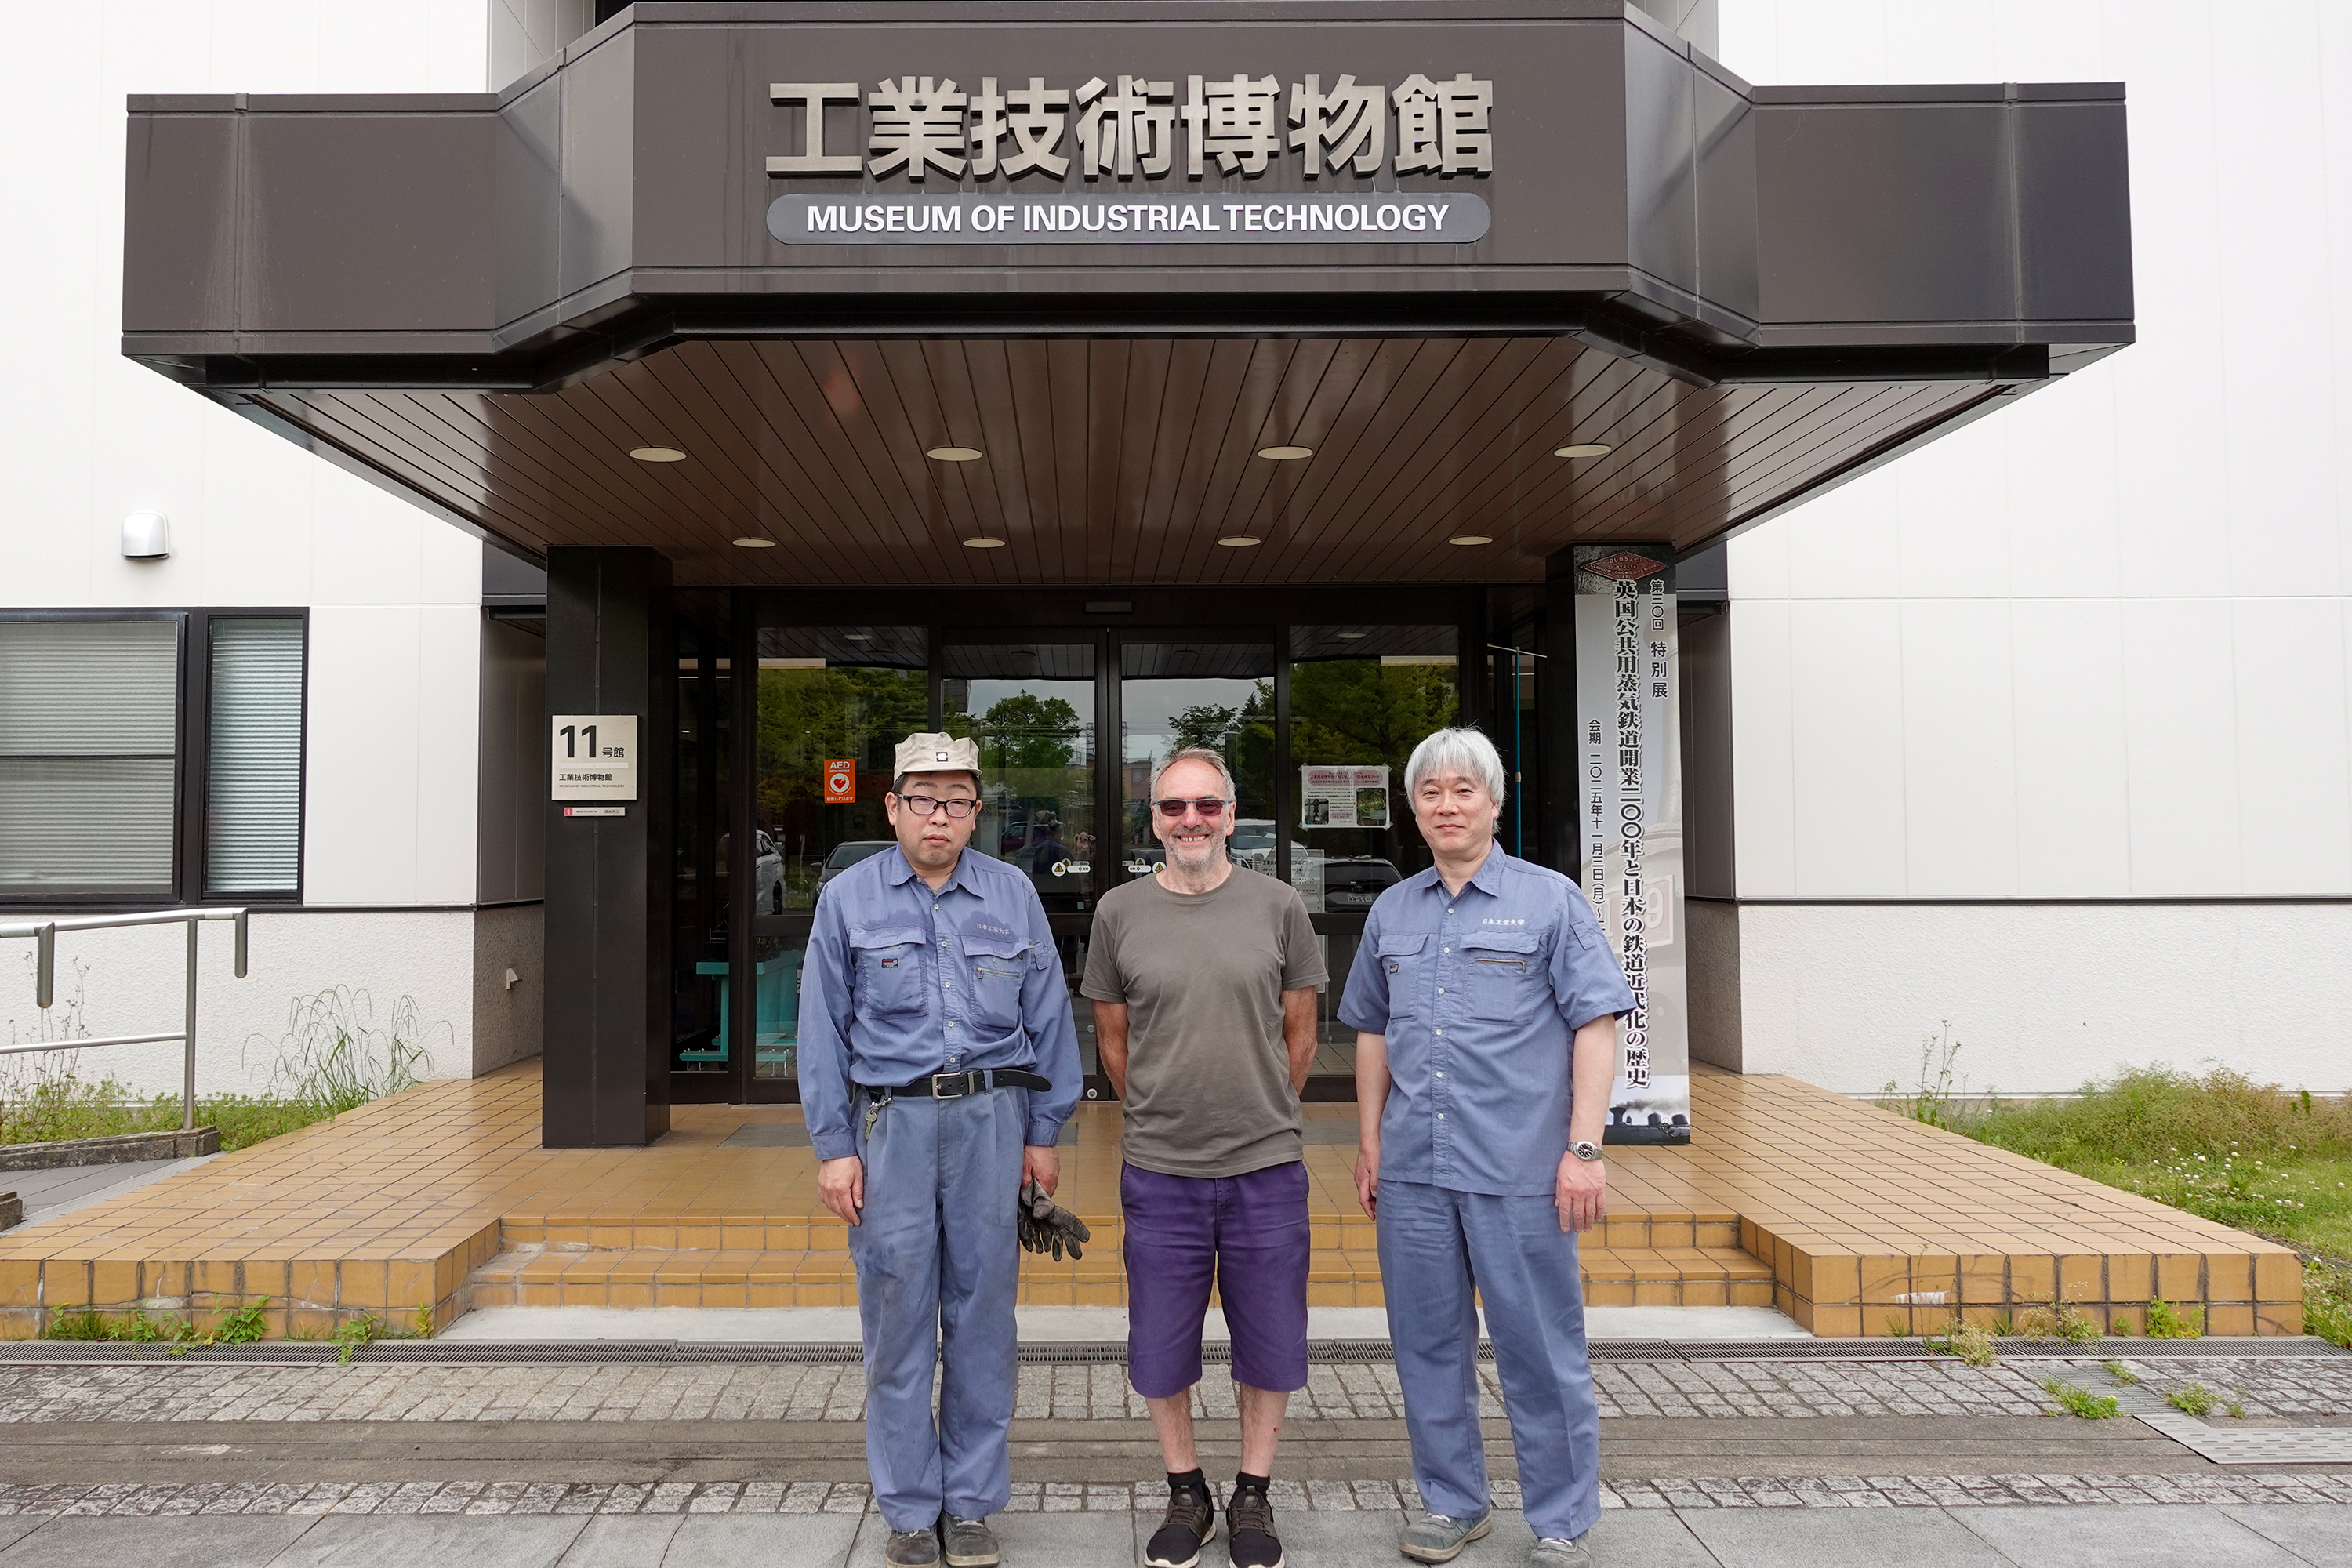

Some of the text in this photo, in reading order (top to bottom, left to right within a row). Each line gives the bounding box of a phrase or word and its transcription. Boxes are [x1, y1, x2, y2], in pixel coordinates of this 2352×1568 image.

[766, 73, 1494, 183] 工業技術博物館
[806, 204, 1450, 233] MUSEUM OF INDUSTRIAL TECHNOLOGY
[1650, 641, 1668, 698] 特別展
[1588, 719, 1602, 745] 会期
[559, 773, 612, 782] 工業技術博物館
[1482, 917, 1526, 926] 日本工業大学
